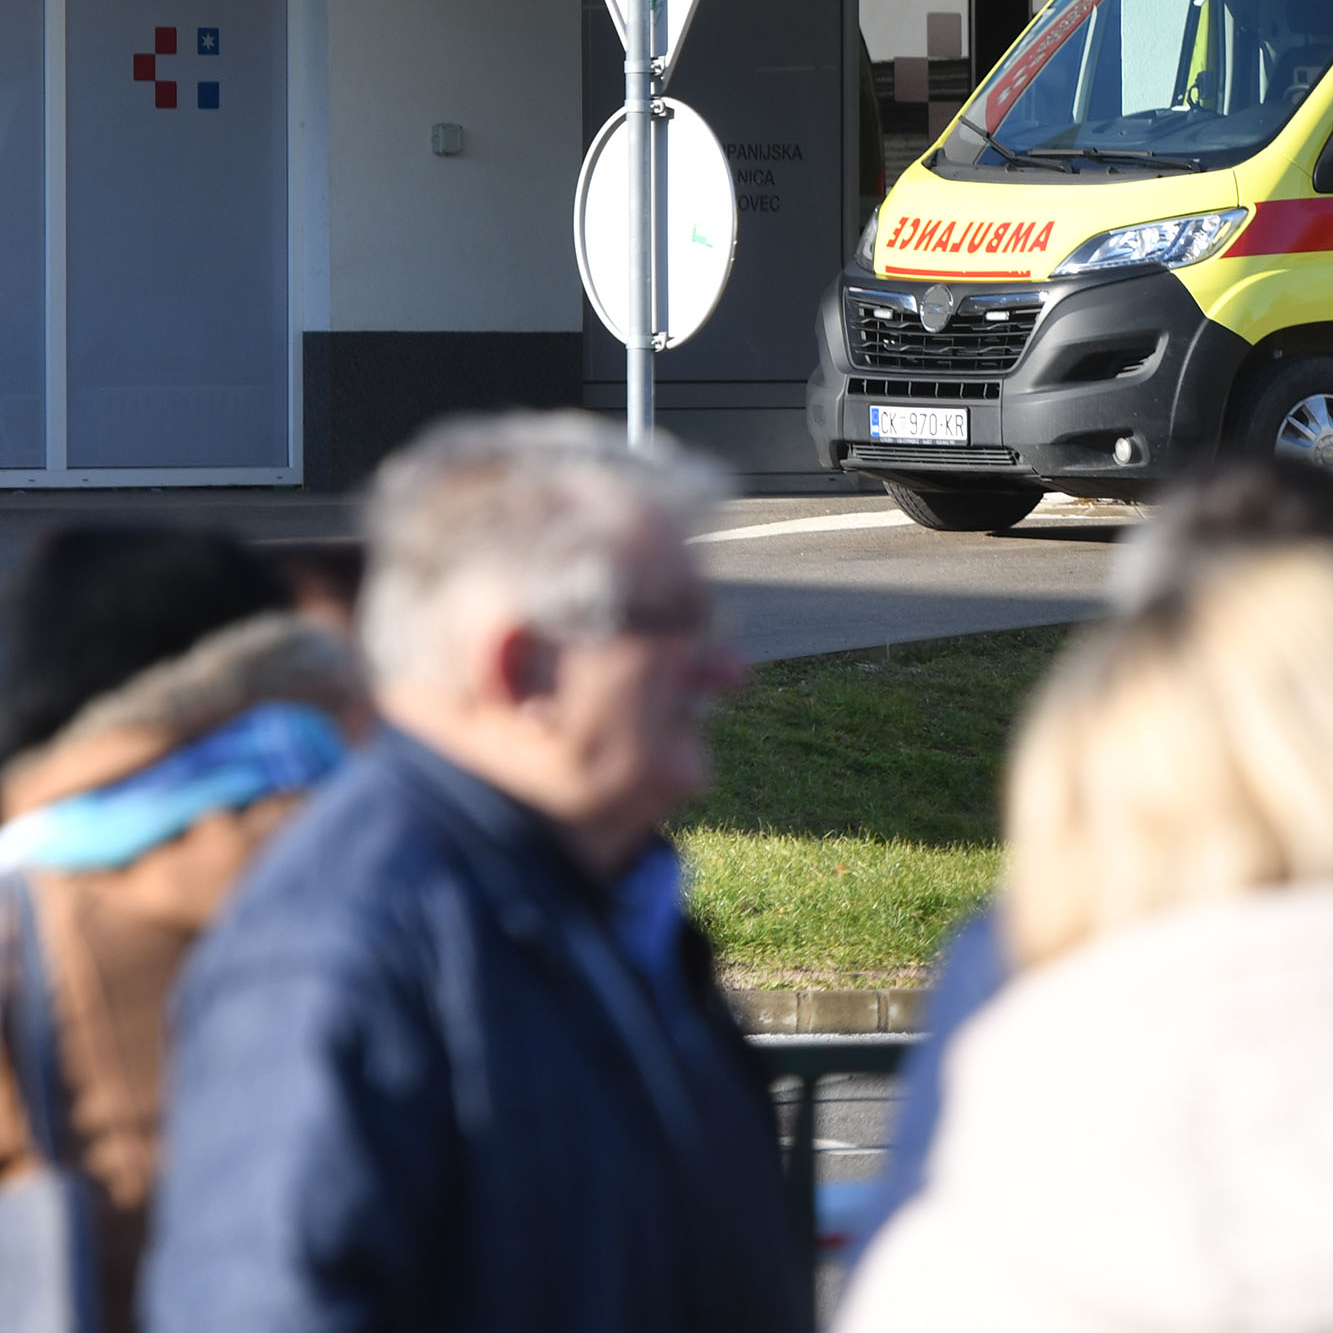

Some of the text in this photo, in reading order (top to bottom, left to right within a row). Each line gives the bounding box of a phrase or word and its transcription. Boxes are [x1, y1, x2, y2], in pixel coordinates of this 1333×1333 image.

[723, 143, 803, 161] PANIJSKA
[736, 169, 776, 185] NICA
[737, 195, 781, 211] OVEC
